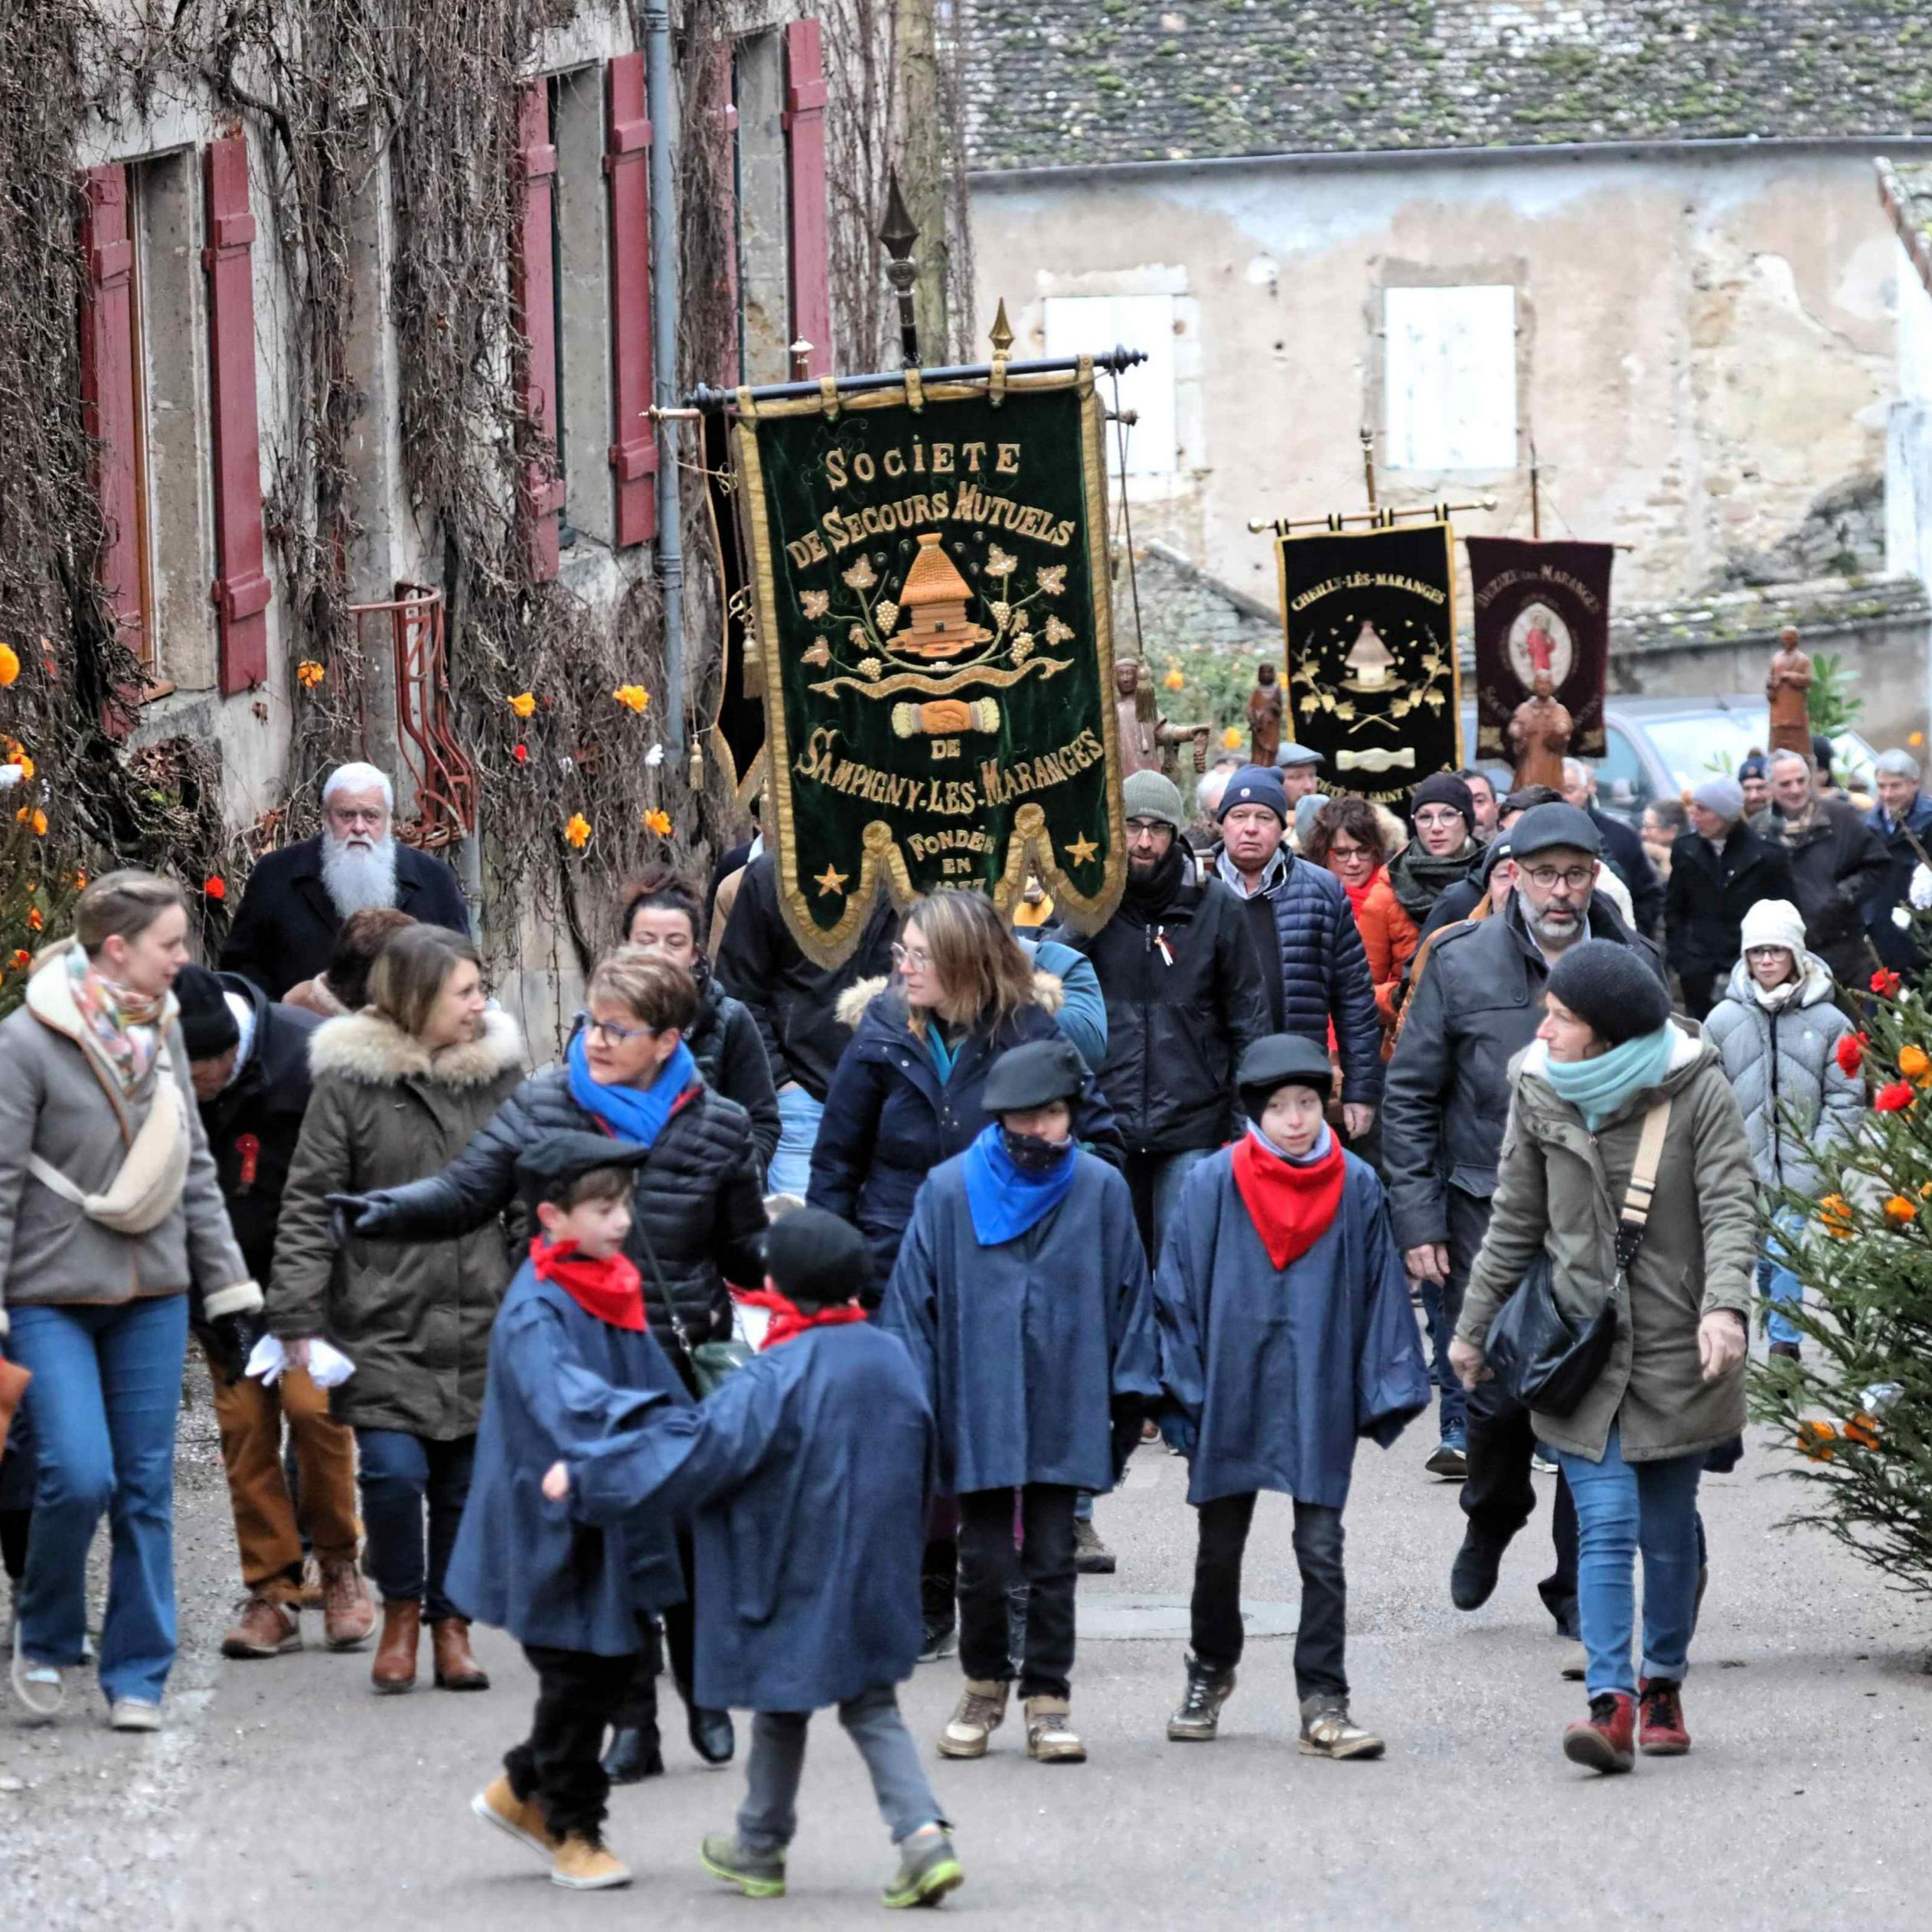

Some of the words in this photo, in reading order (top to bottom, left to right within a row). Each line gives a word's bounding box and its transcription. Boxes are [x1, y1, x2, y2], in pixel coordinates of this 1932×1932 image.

[786, 530, 828, 569] DE
[822, 491, 949, 554] SECOURS
[951, 481, 1075, 547] MUTUELS
[931, 739, 961, 759] DE
[942, 857, 971, 873] EN
